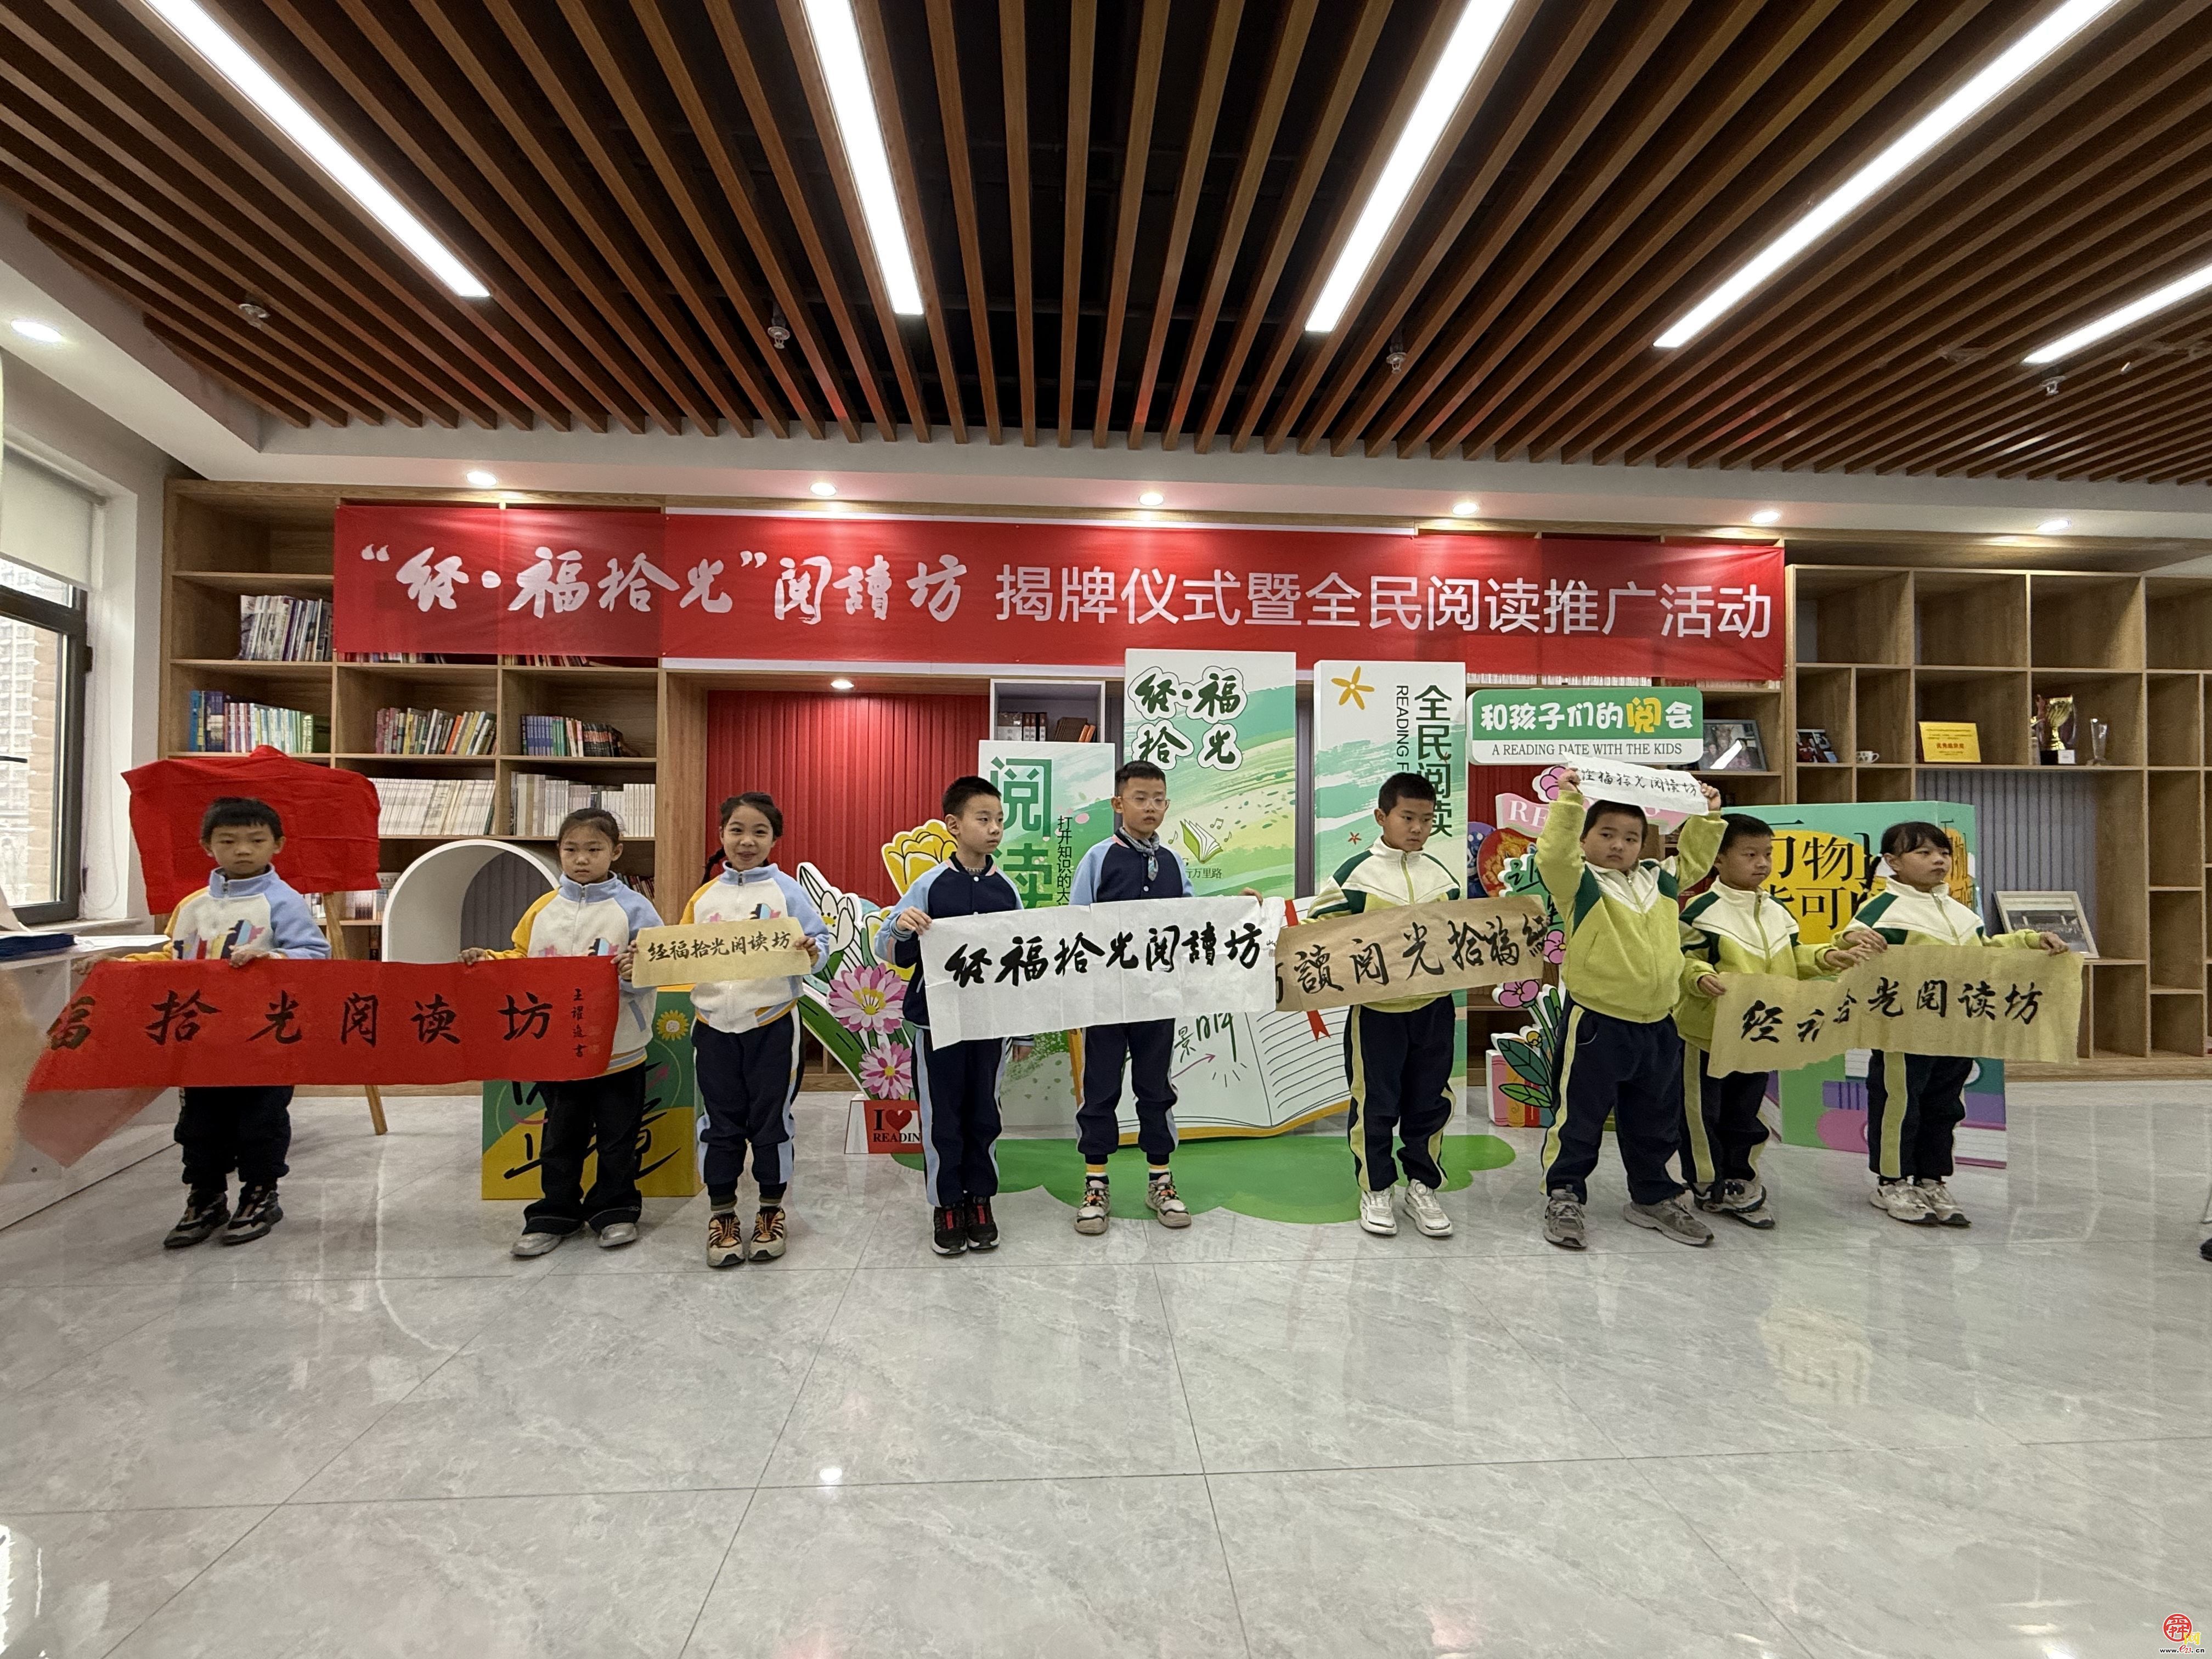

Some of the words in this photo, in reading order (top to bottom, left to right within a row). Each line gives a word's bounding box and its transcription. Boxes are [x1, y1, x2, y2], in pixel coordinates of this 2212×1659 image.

[995, 564, 1773, 639] 揭牌仪式暨全民阅读推广活动
[1396, 685, 1409, 757] READING
[1480, 697, 1694, 734] 和孩子们的阅会
[1137, 726, 1235, 764] 拾光
[1492, 744, 1499, 755] A
[1503, 744, 1555, 755] READING
[1559, 744, 1589, 755] DATE
[1593, 743, 1623, 755] WITH
[1626, 743, 1650, 754] THE
[1654, 743, 1682, 754] KIDS
[1056, 815, 1073, 905] 打开知识的大
[873, 1109, 885, 1131] I
[873, 1132, 921, 1143] READIN
